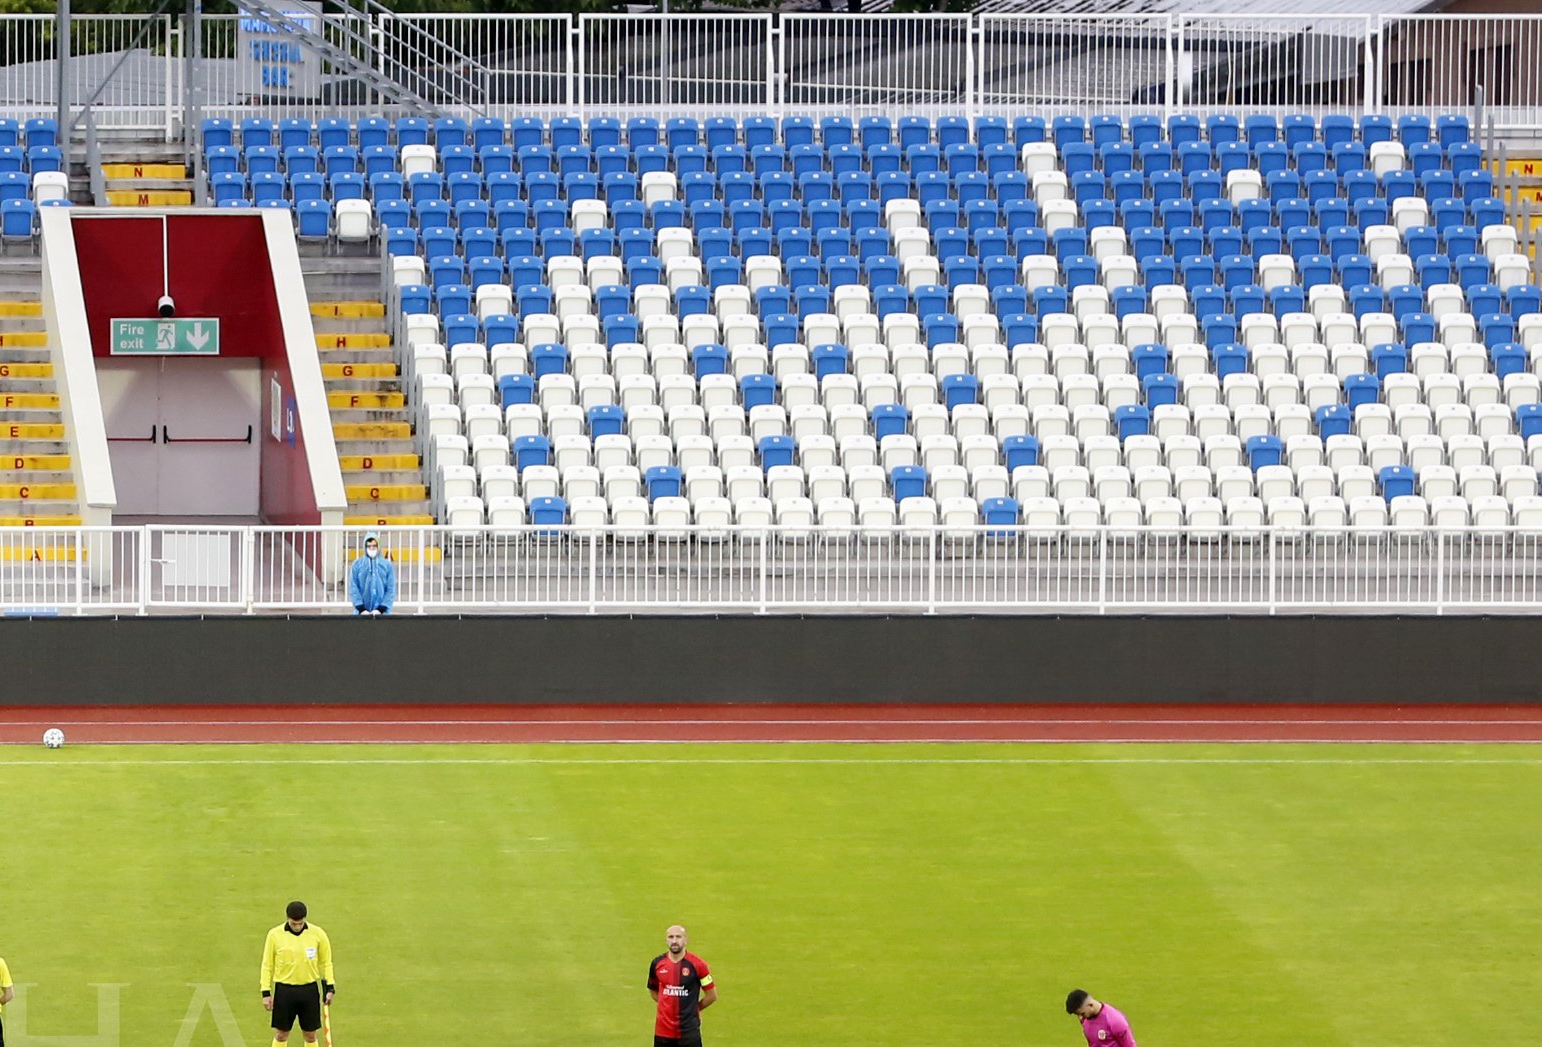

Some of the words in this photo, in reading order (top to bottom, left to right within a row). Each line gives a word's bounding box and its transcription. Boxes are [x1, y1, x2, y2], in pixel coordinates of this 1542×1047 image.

[134, 166, 144, 177] N
[1524, 164, 1534, 176] N
[138, 195, 150, 205] M
[119, 323, 145, 335] Fire
[120, 338, 144, 349] exit
[335, 337, 347, 348] H
[0, 366, 10, 378] G
[342, 365, 354, 378] G
[5, 396, 14, 408] F
[350, 395, 361, 408] F
[10, 426, 20, 438] E
[15, 458, 26, 471] D
[362, 457, 374, 470] D
[19, 487, 31, 499] C
[370, 488, 381, 501] C
